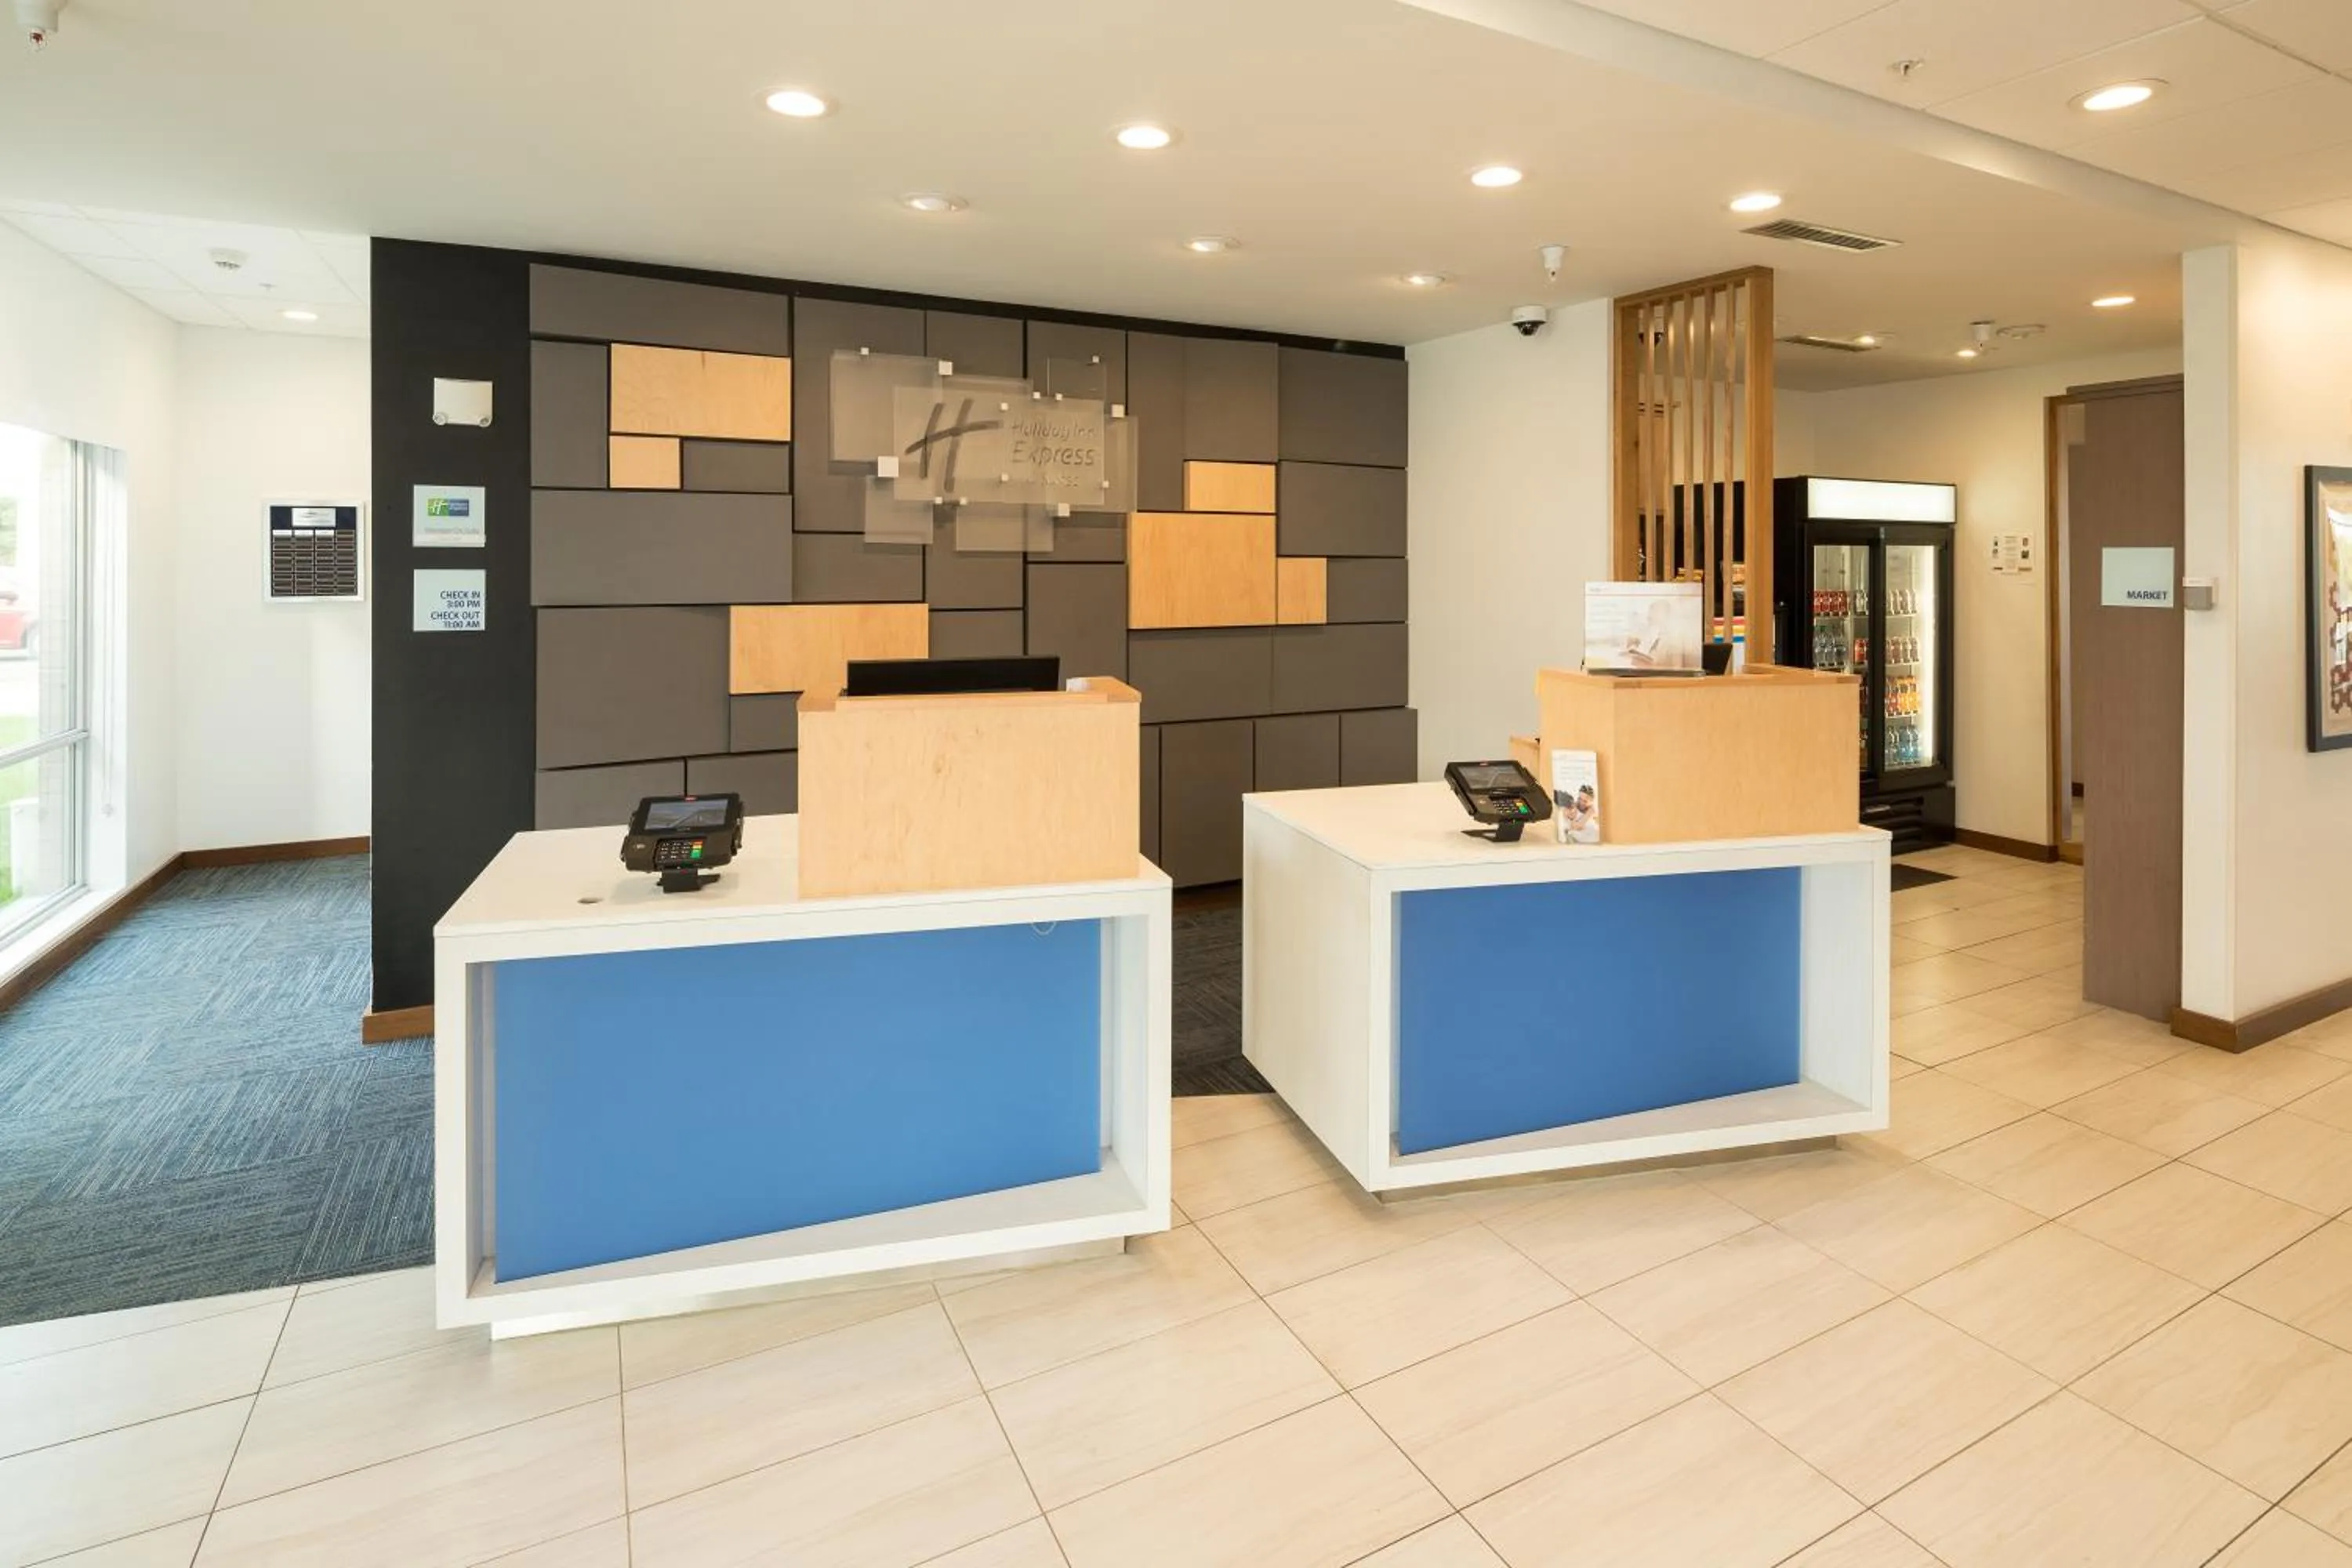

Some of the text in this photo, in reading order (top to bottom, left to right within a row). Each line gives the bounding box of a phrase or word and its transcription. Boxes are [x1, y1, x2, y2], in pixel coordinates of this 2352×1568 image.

[1012, 441, 1094, 466] Express
[440, 590, 469, 599] CHECK
[2127, 590, 2168, 600] MARKET
[447, 600, 465, 608] 3:00
[430, 612, 459, 620] CHECK
